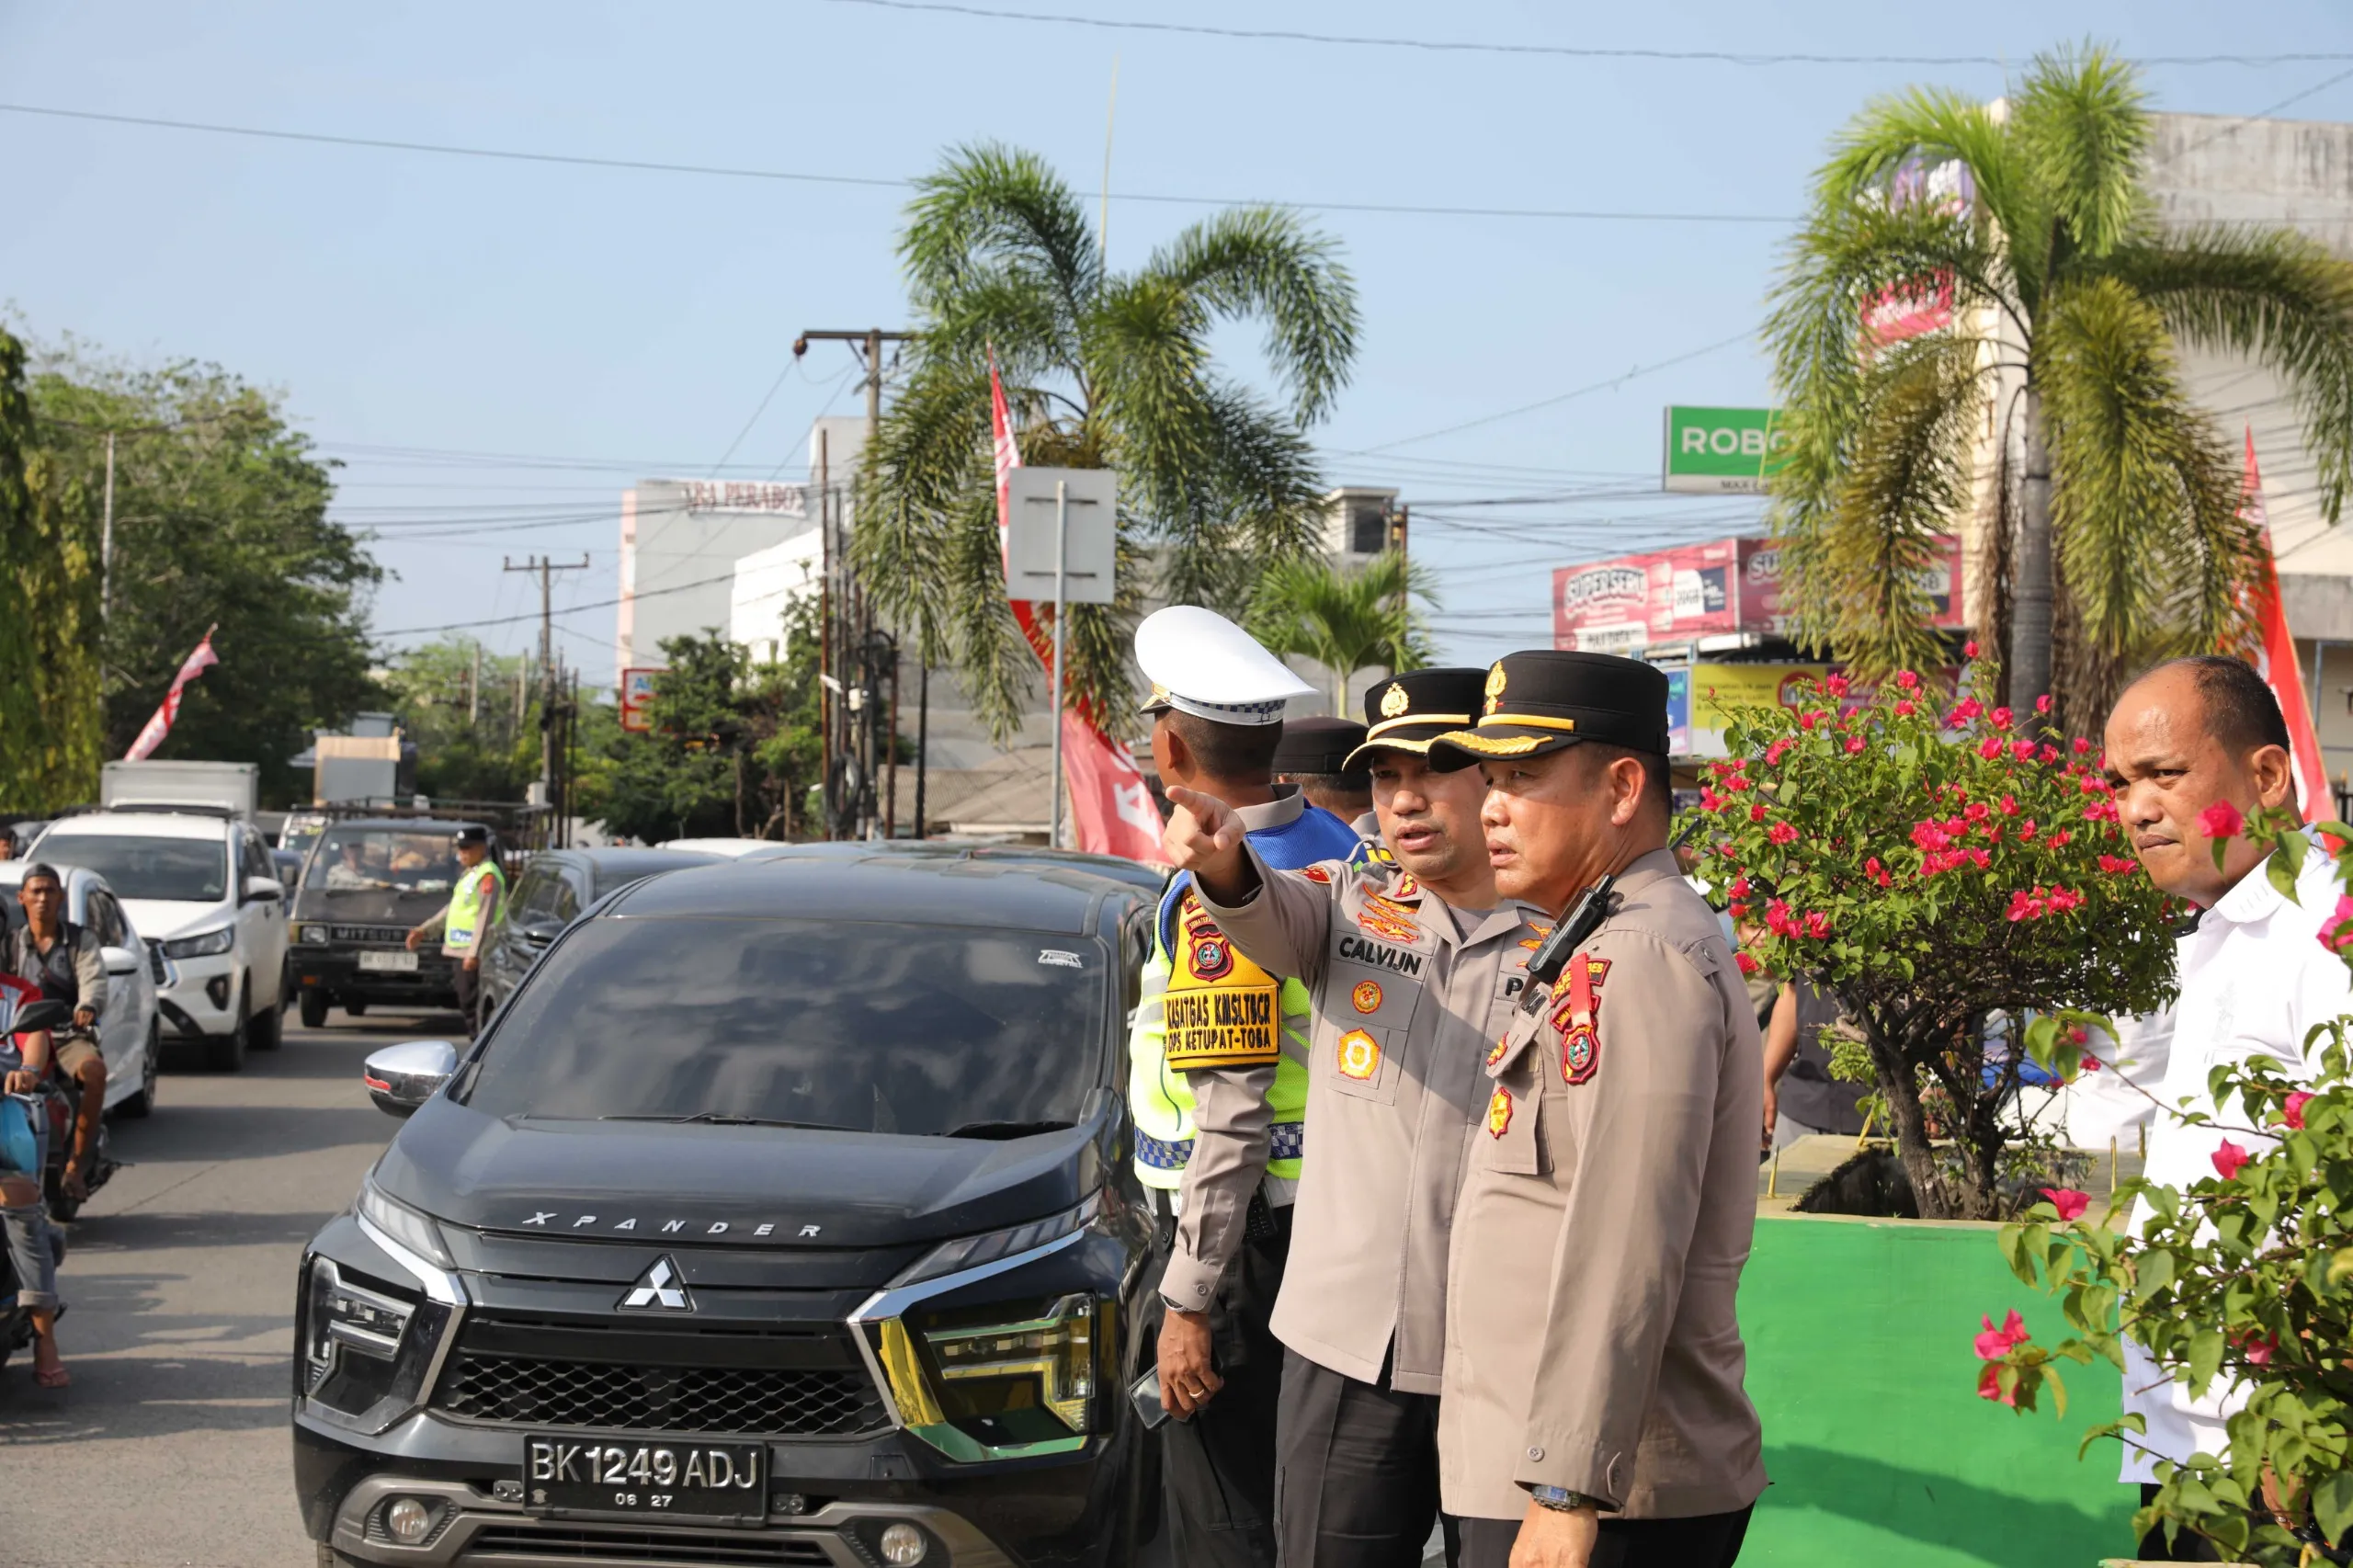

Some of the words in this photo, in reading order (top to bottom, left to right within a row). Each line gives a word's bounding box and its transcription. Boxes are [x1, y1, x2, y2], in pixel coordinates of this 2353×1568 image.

[724, 483, 803, 511] PERABO
[1339, 937, 1422, 975] CALVIJN
[1166, 994, 1209, 1029] KASATGAS
[1168, 1031, 1182, 1052] OPS
[1185, 1028, 1271, 1051] KETUPAT-TOBA
[522, 1211, 821, 1237] XPANDER
[531, 1443, 581, 1483] BK
[585, 1446, 677, 1486] 1249
[682, 1450, 757, 1489] ADJ
[615, 1493, 637, 1506] 06
[651, 1494, 673, 1507] 27
